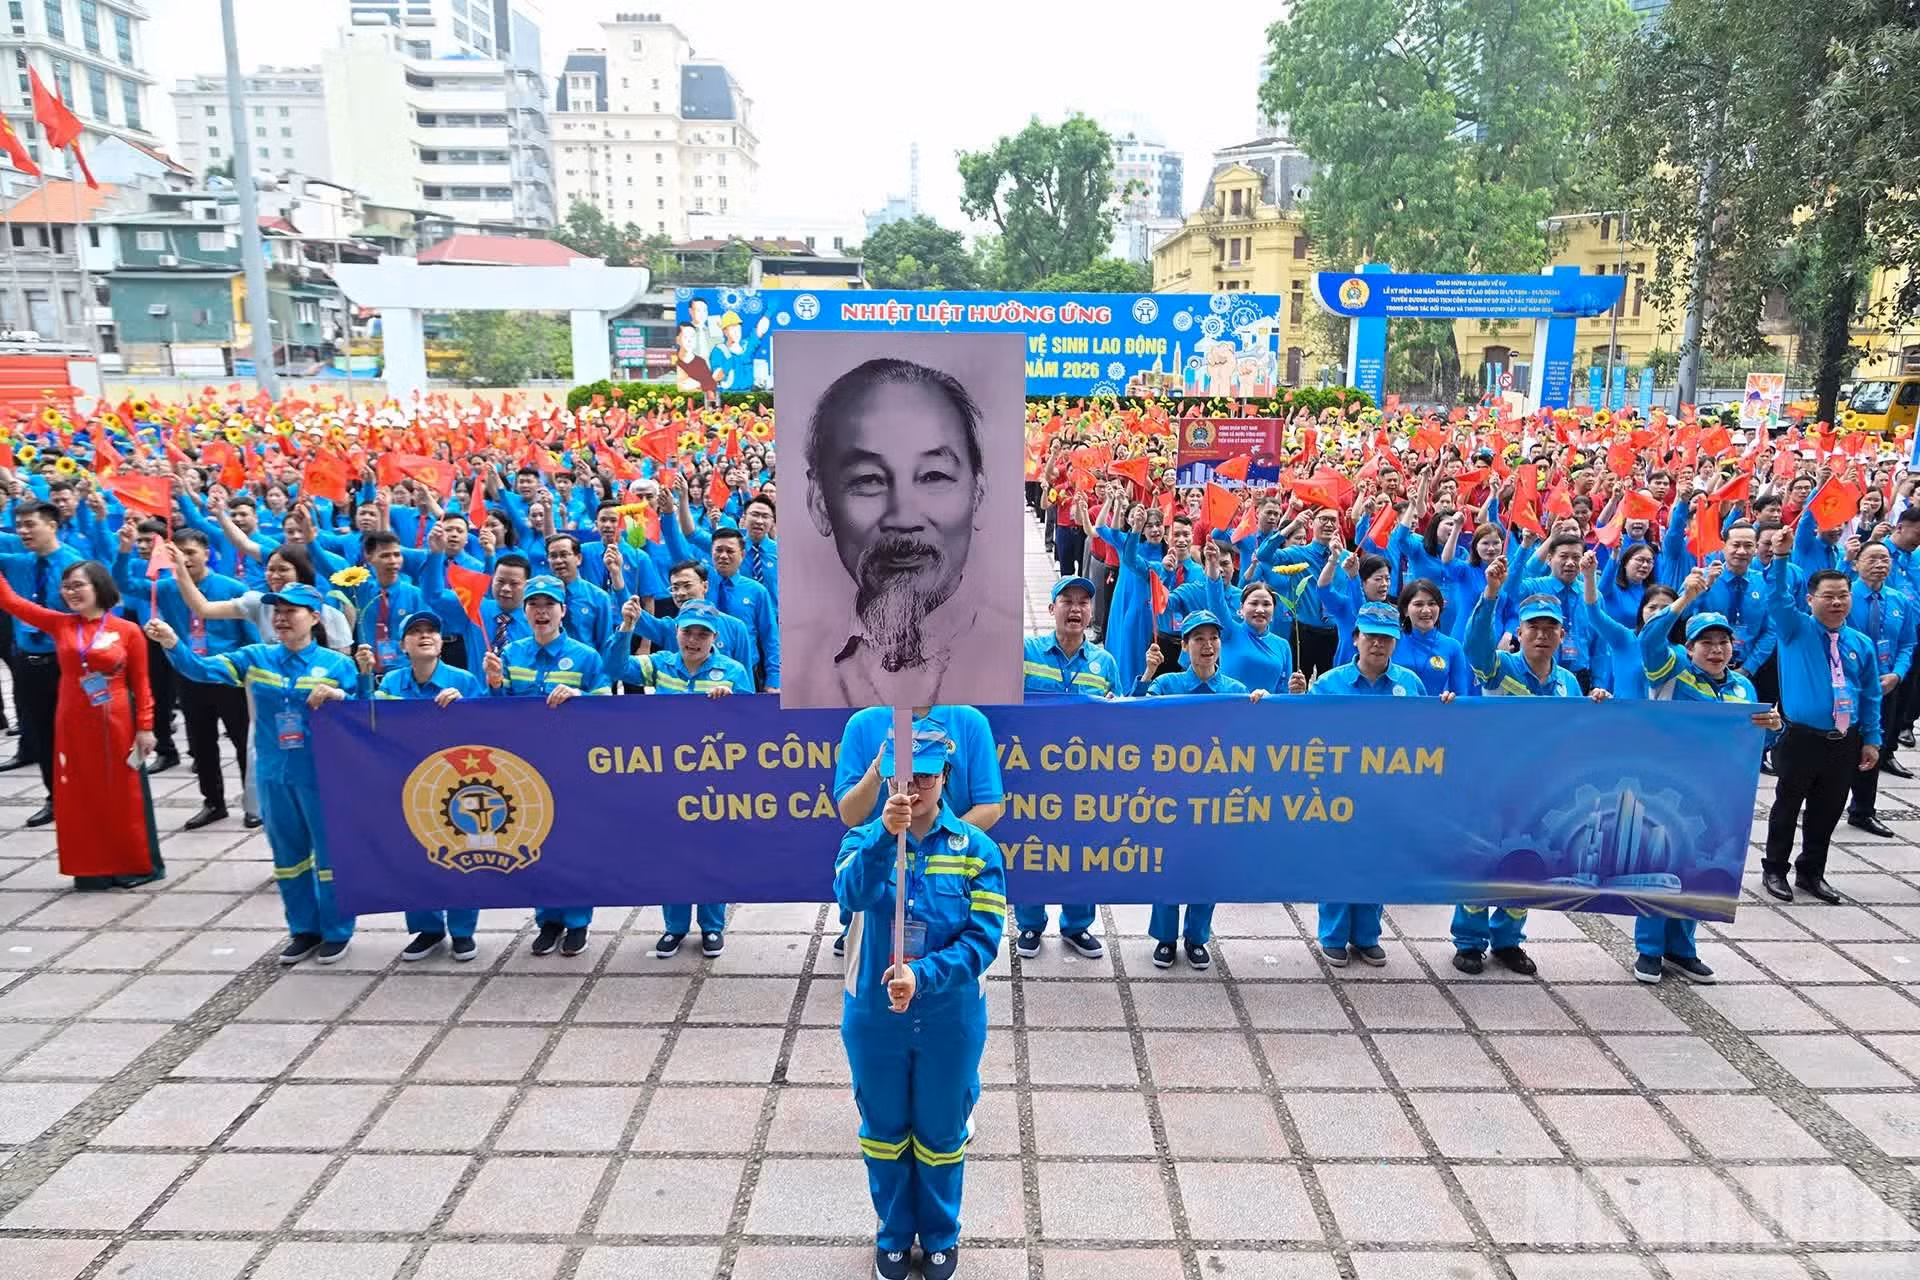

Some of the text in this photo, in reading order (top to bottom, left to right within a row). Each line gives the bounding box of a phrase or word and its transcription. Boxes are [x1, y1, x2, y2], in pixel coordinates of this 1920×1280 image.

[842, 299, 1111, 326] NHIỆT LIỆT HƯỞNG ỨNG
[1029, 334, 1167, 358] VỆ SINH LAO ĐỘNG
[1026, 358, 1100, 378] NĂM 2026
[588, 746, 663, 774] GIAI
[674, 732, 747, 772] CẤP
[758, 733, 841, 769] CÔN
[1040, 736, 1140, 771] CÔNG
[1152, 736, 1256, 774] ĐOÀN
[1266, 737, 1350, 780] VIỆT
[1360, 746, 1445, 775] NAM
[678, 784, 1354, 824] CÙNG CẢ NG BƯỚC TIẾN VÀO
[999, 834, 1164, 872] YÊN MỚI!
